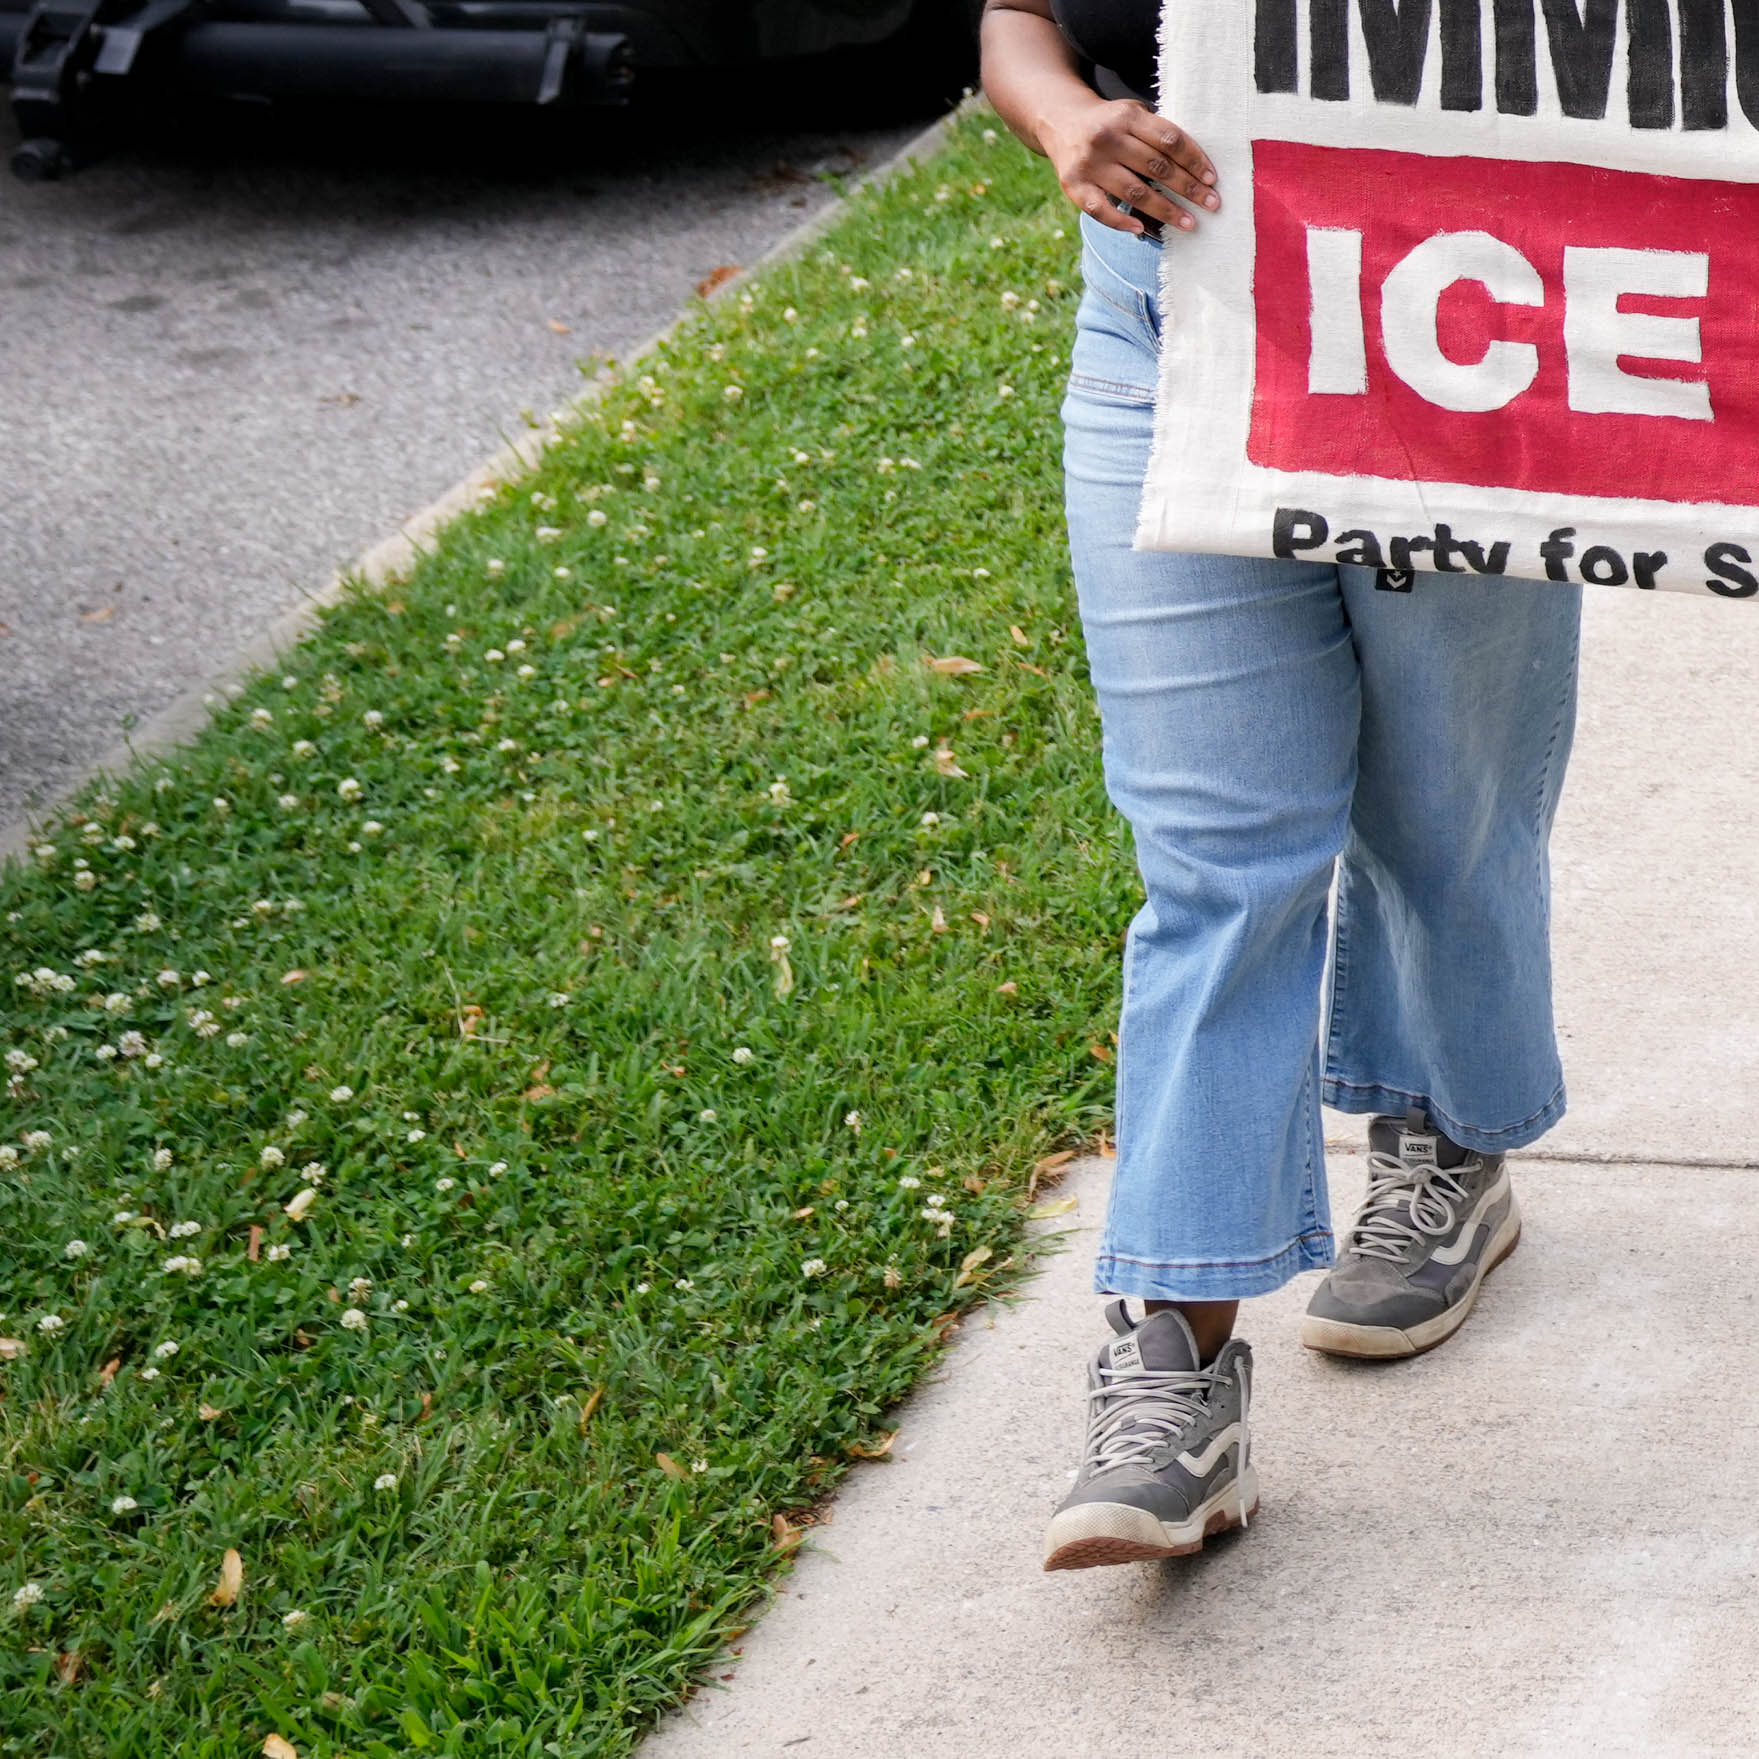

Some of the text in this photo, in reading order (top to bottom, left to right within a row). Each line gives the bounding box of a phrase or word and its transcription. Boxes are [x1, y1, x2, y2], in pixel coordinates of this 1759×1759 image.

[1303, 225, 1714, 424] ICE
[1273, 507, 1512, 574] Party
[1541, 527, 1668, 589] for
